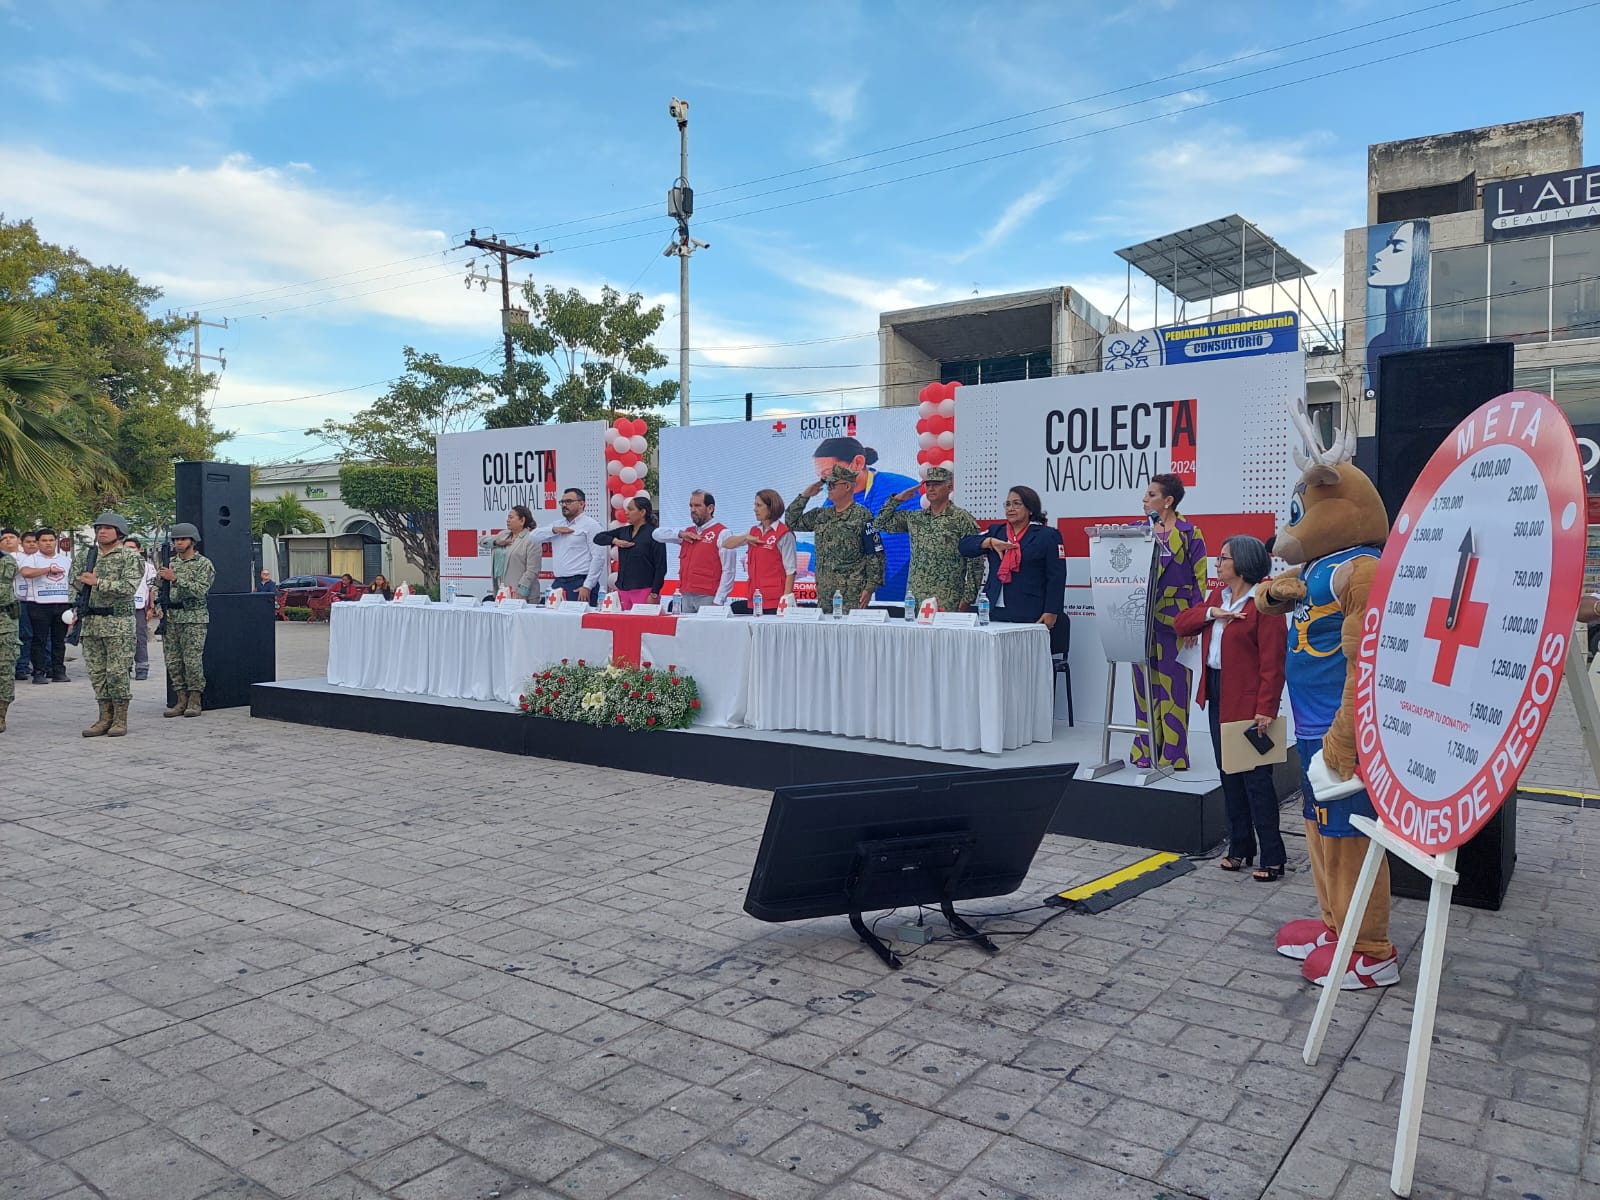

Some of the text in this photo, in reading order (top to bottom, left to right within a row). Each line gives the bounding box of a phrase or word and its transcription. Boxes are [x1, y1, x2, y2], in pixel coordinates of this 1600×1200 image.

[1500, 209, 1572, 228] BEAUTY
[1165, 315, 1294, 342] PEDIATRÍA Y NEUROPEDIATRÍA
[1193, 335, 1263, 354] CONSULTORIO
[800, 415, 856, 431] COLECTA
[1046, 399, 1197, 456] COLECTA
[1456, 401, 1542, 460] META
[800, 428, 843, 440] NACIONAL
[482, 450, 556, 485] COLECTA
[1171, 460, 1196, 474] 2024
[1470, 457, 1512, 480] 4,000,000
[483, 484, 543, 511] NACIONAL
[1432, 495, 1464, 511] 3,750,000
[1507, 484, 1538, 503] 250,000
[1413, 527, 1443, 542] 3,500,000
[1513, 520, 1545, 538] 500,000
[1094, 574, 1146, 584] MAZATLÁN
[1398, 565, 1427, 580] 3,250,000
[1512, 571, 1543, 588] 750,000
[1388, 600, 1417, 617] 3,000,000
[1501, 615, 1538, 635] 1,000,000
[1380, 634, 1409, 652] 2,750,000
[1491, 658, 1527, 681] 1,250,000
[1378, 673, 1407, 694] 2,500,000
[1422, 707, 1435, 720] POR
[1434, 710, 1442, 722] TU
[1469, 701, 1503, 725] 1,500,000
[1356, 607, 1565, 845] CUATRO MILLONES DE PESOS
[1382, 714, 1411, 736] 2,250,000
[1447, 740, 1479, 766] 1,750,000
[1407, 758, 1437, 784] 2,000,000
